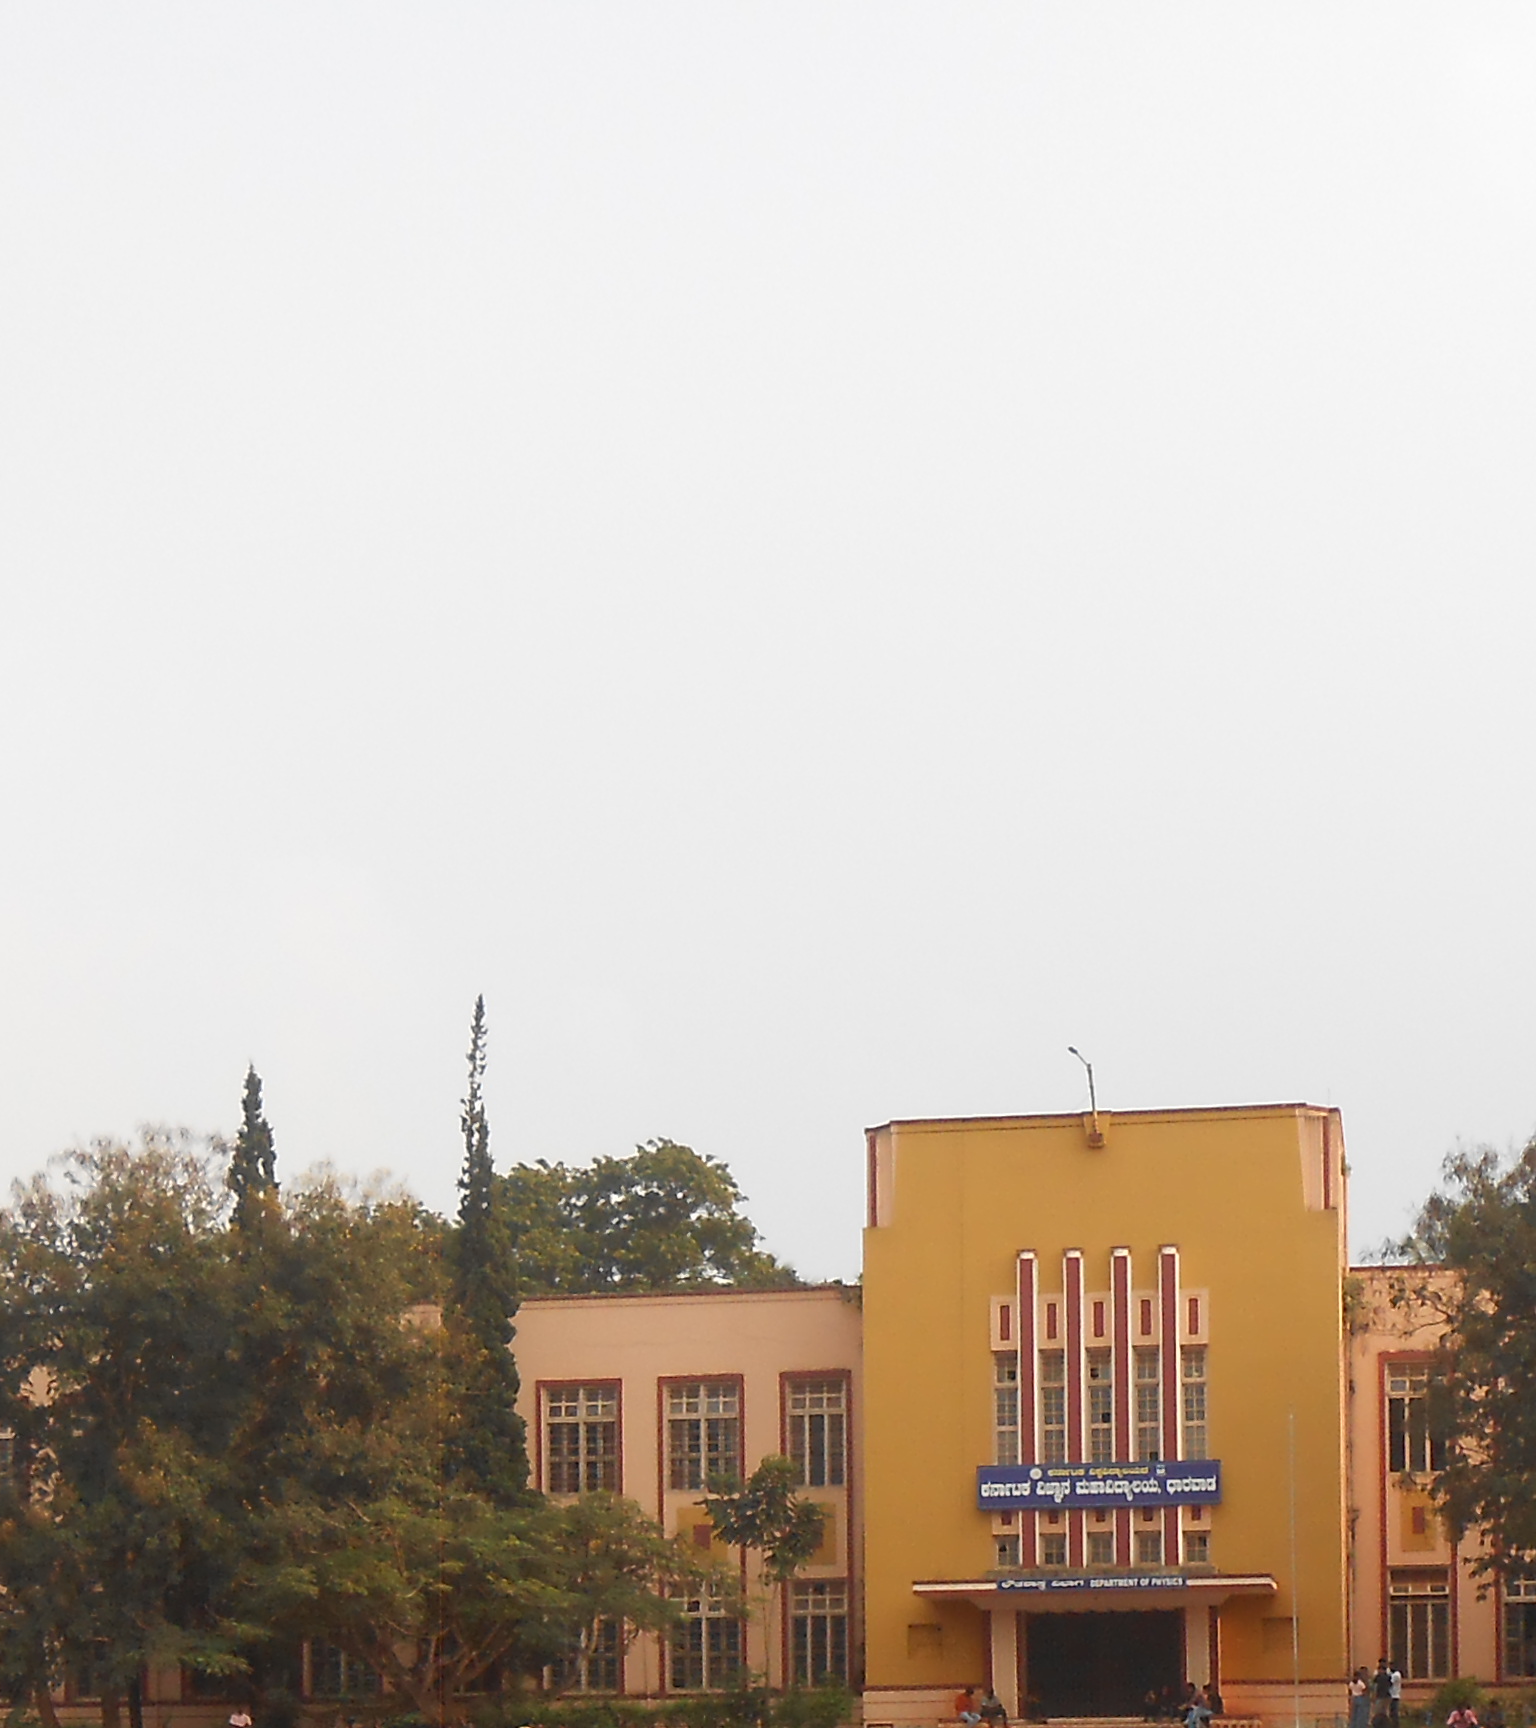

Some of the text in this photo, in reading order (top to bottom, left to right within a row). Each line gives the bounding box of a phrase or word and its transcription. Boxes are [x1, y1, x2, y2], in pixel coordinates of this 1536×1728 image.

[980, 1479, 1031, 1497] ಕರ್ನಾಟಕ
[1036, 1478, 1071, 1503] ವಿಜ್ಞಾನ
[1166, 1475, 1217, 1496] ಧಾರವಾಡ
[1090, 1578, 1183, 1587] DEPARTMENT OF PHYSICS
